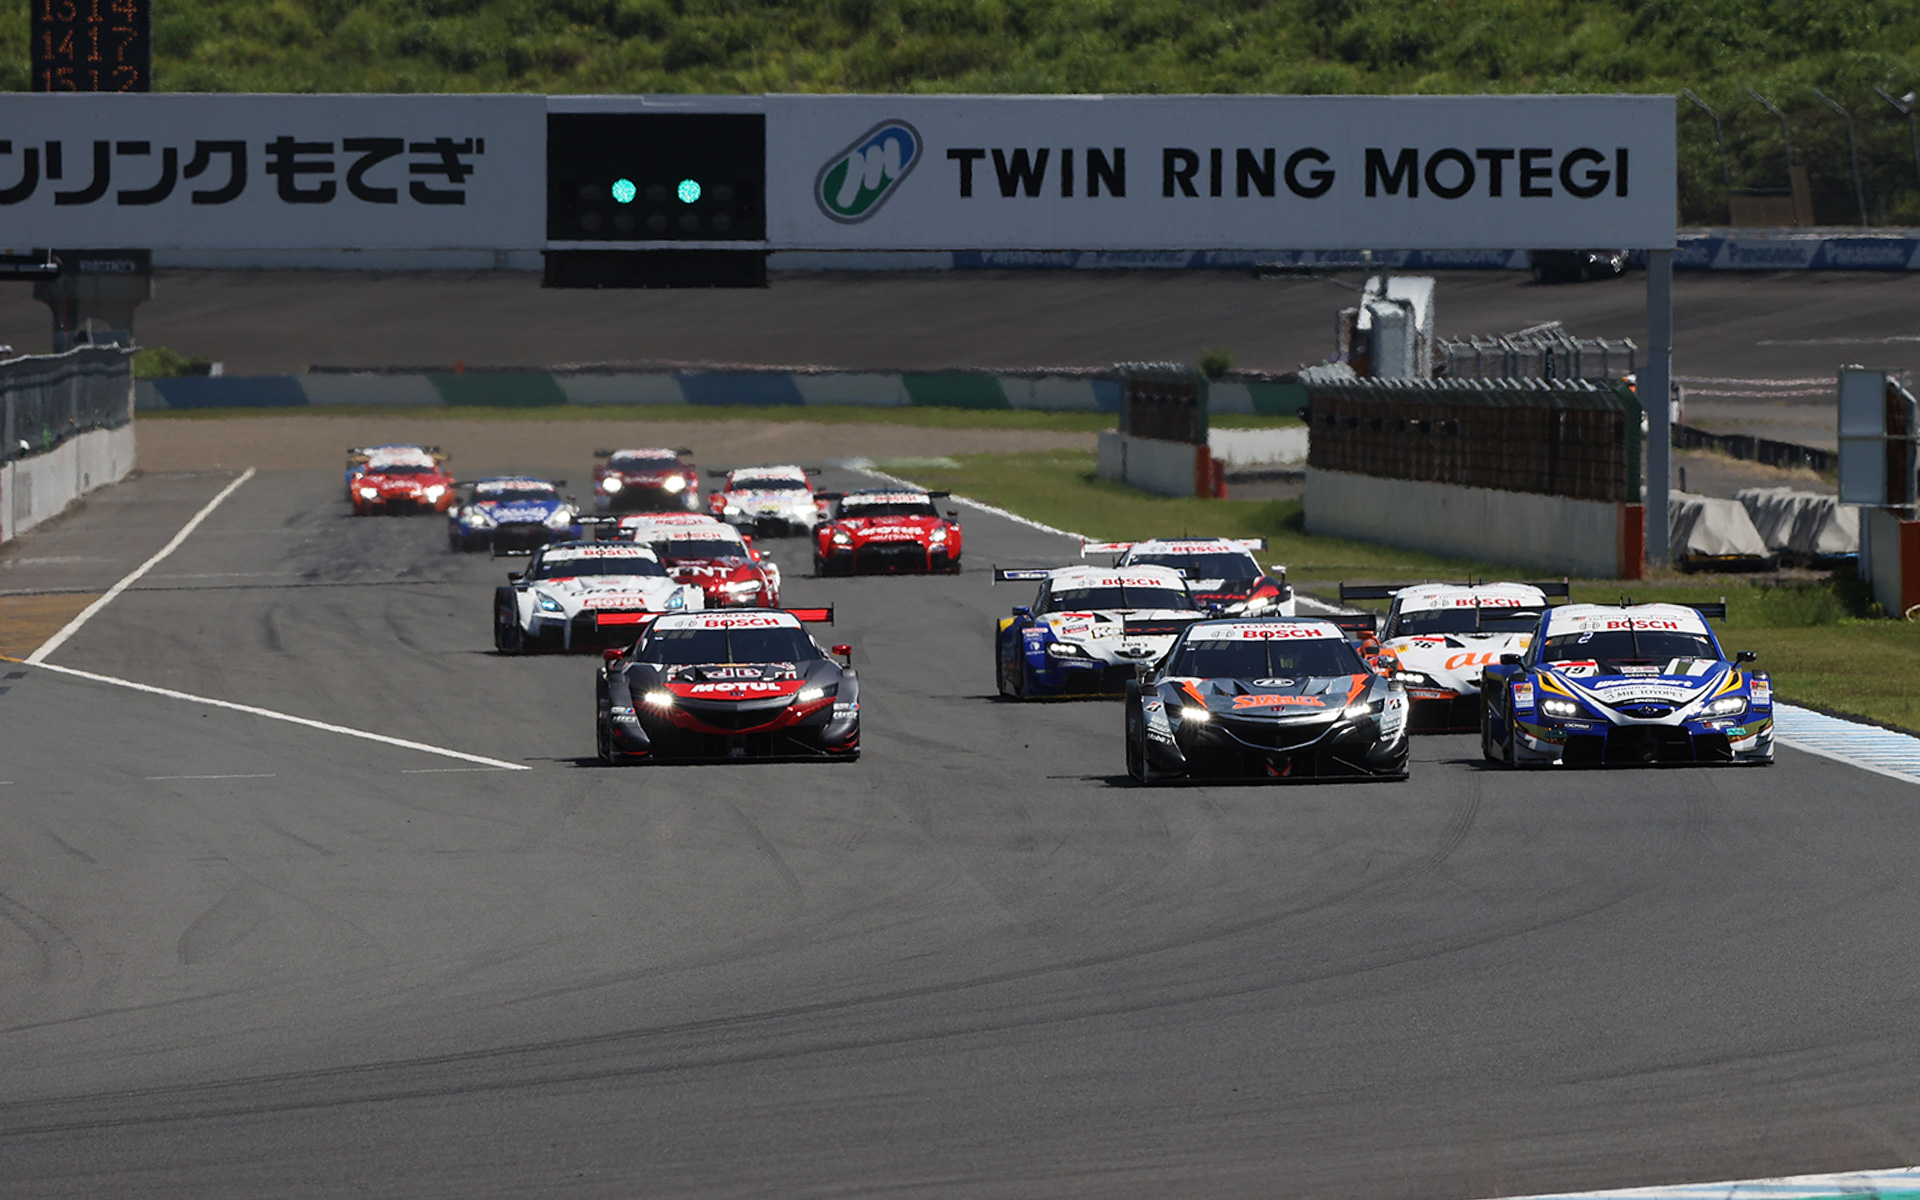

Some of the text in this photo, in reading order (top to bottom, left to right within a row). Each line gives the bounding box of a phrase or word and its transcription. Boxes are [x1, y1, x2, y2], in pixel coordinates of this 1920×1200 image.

[42, 29, 74, 60] 14
[947, 147, 1629, 199] TWIN RING MOTEGI
[1102, 578, 1161, 586] BOSCH
[1455, 598, 1522, 607] BOSCH
[704, 618, 780, 628] BOSCH
[1607, 620, 1678, 629] BOSCH
[1243, 629, 1323, 639] BOSCH
[1445, 651, 1500, 671] au
[690, 682, 781, 692] MOTUL
[1233, 694, 1326, 710] STANLEY
